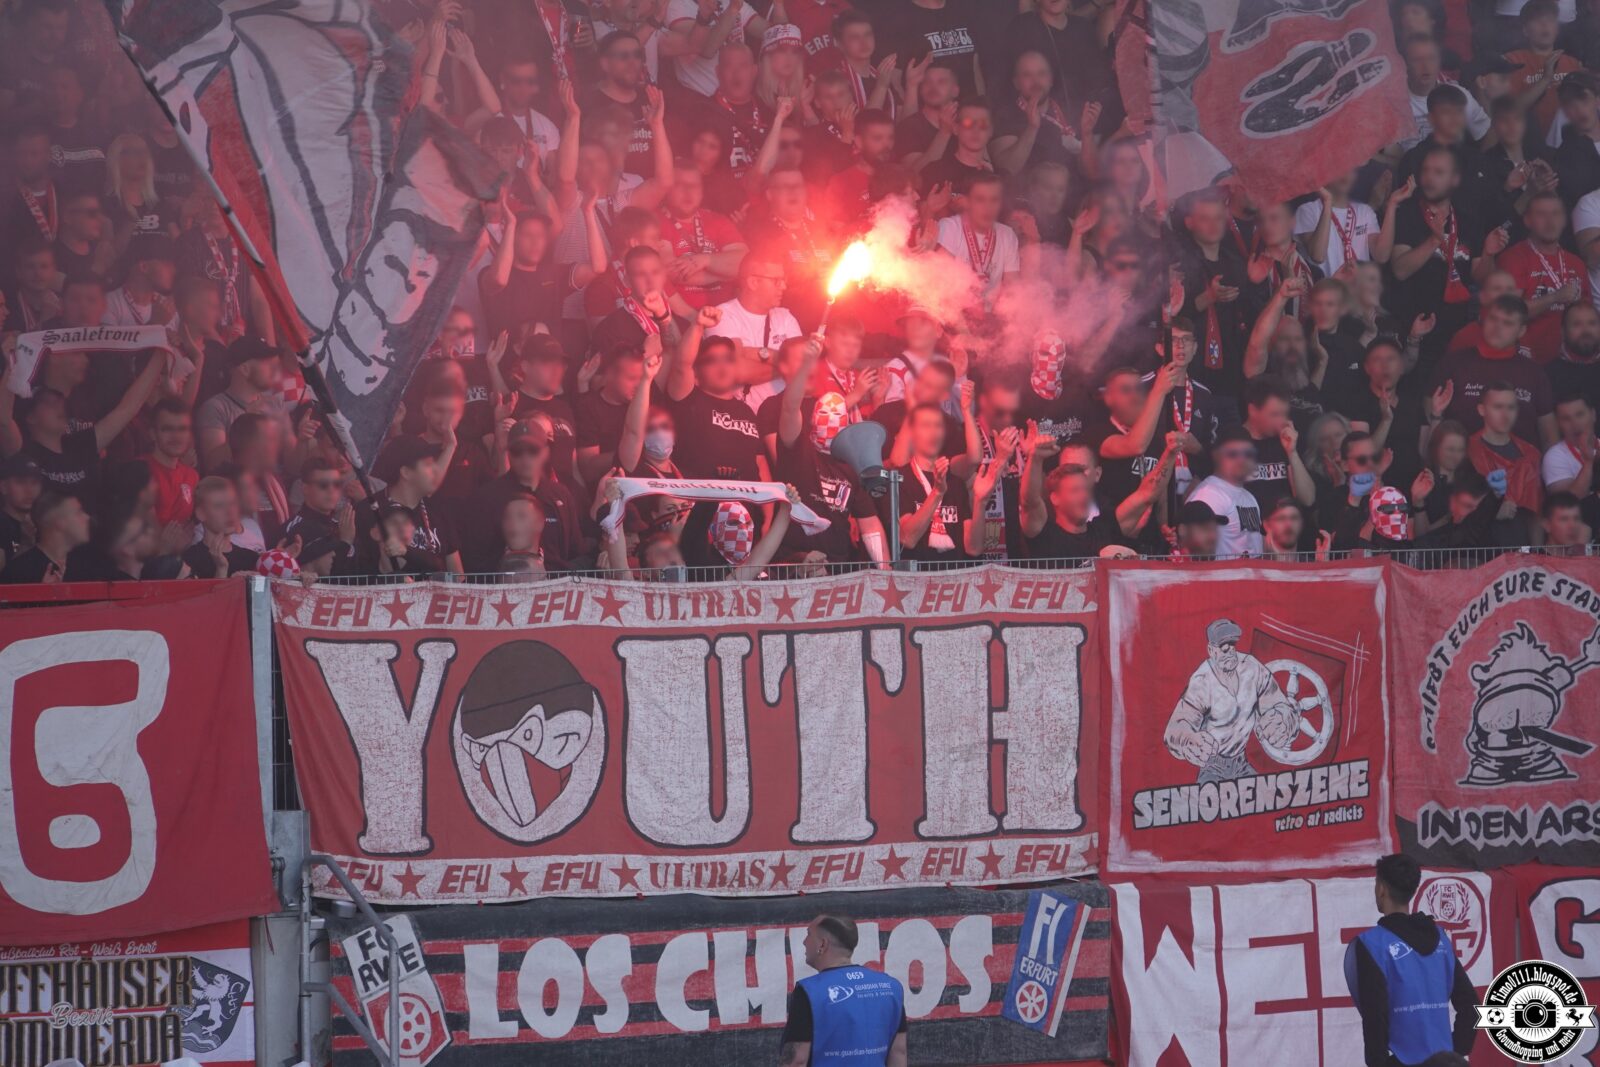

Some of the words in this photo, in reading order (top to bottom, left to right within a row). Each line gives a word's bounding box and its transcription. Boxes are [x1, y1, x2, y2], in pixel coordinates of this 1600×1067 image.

[41, 325, 141, 345] Saalefront
[310, 596, 373, 627] EFU
[424, 594, 486, 626] EFU
[527, 590, 583, 625] EFU
[644, 588, 762, 622] ULTRAS
[807, 583, 865, 620] EFU
[918, 582, 969, 614] EFU
[1011, 580, 1071, 611] EFU
[1448, 592, 1490, 648] EUCH
[1493, 571, 1546, 604] EURE
[1551, 577, 1600, 621] STAD
[1133, 759, 1370, 830] SENIORENSZENE
[1420, 807, 1462, 841] IN
[1467, 808, 1529, 841] DEN
[437, 863, 492, 893] EFU
[541, 861, 602, 892] EFU
[648, 858, 768, 890] ULTRAS
[803, 852, 865, 886] EFU
[919, 846, 969, 876] EFU
[1013, 843, 1071, 874] EFU
[0, 945, 56, 961] ußballclub
[1020, 956, 1058, 986] ERFURT
[463, 933, 633, 1039] LOS
